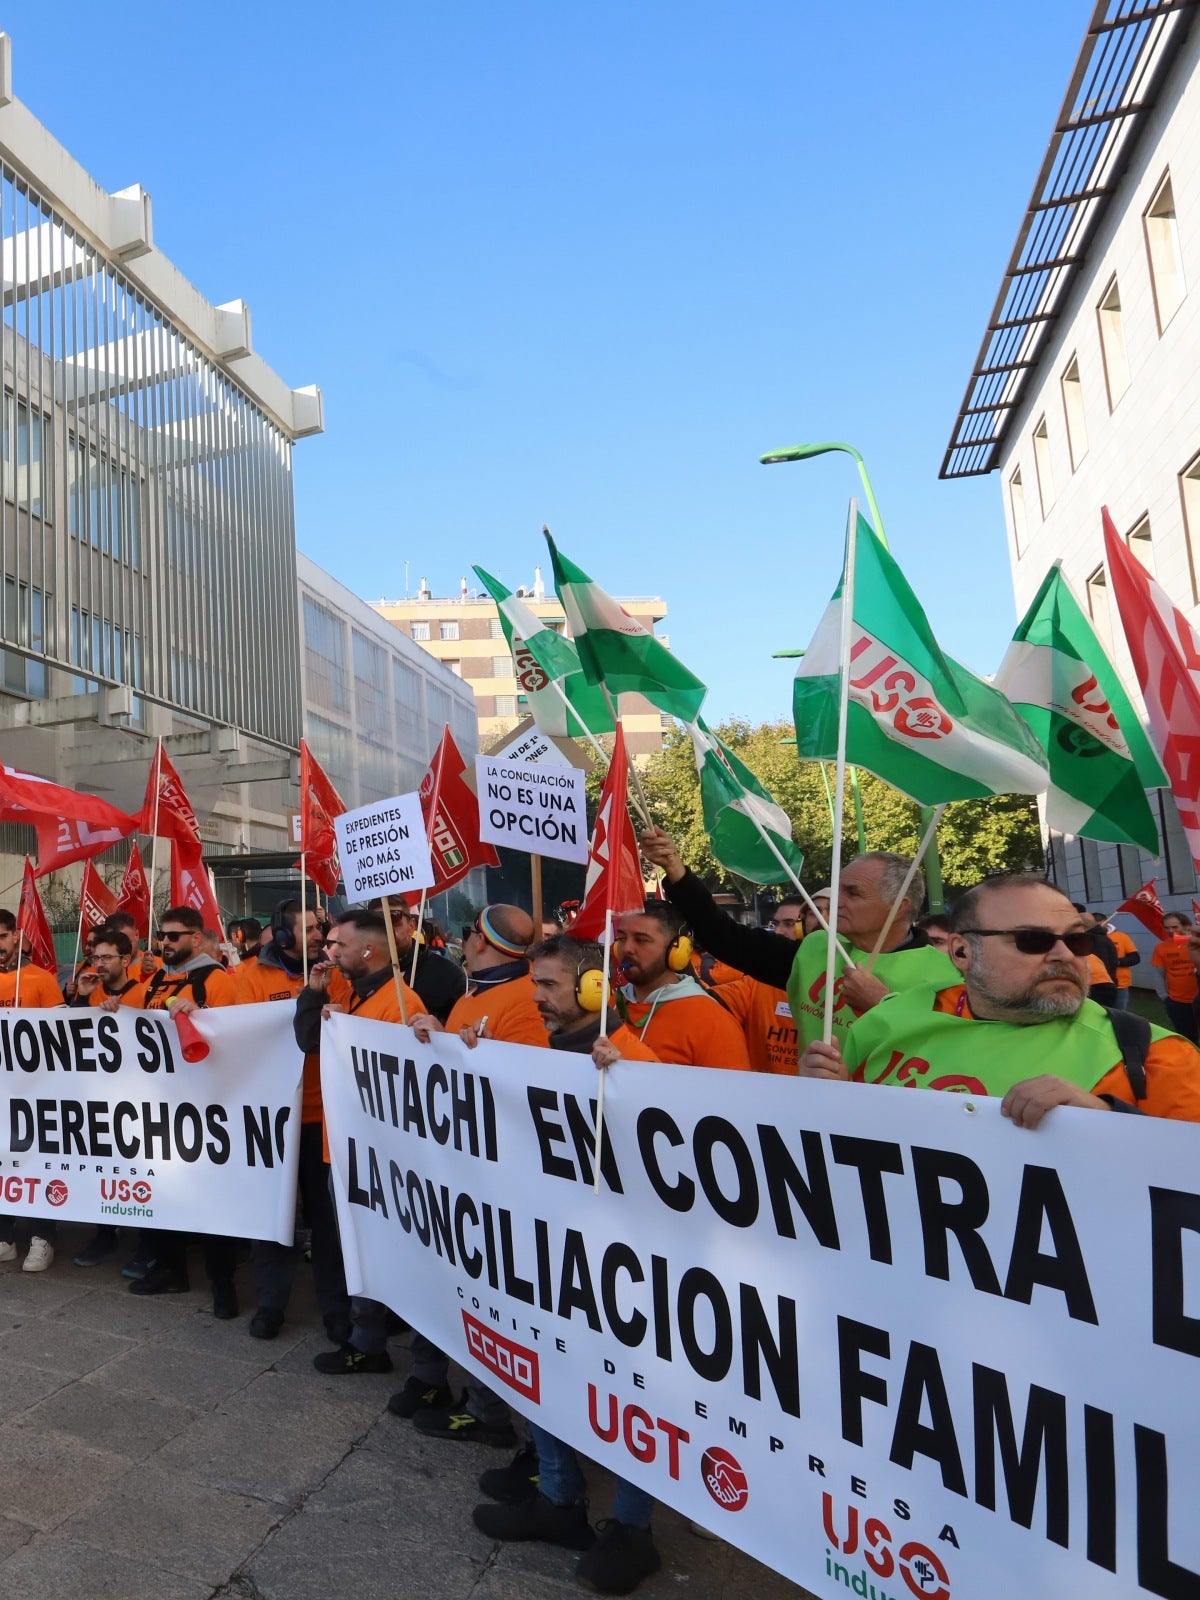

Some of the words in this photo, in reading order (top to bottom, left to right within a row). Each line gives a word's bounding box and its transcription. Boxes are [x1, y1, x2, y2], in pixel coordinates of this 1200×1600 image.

[849, 636, 953, 739] USO
[518, 742, 531, 754] DE
[487, 766, 497, 777] LA
[500, 768, 574, 789] CONCILIACIÓN
[488, 783, 511, 801] NO
[517, 788, 533, 805] ES
[539, 792, 576, 813] UNA
[345, 808, 401, 834] EXPEDIENTES
[489, 809, 576, 844] OPCIÓN
[346, 840, 357, 854] DE
[360, 824, 409, 850] PRESIÓN
[357, 855, 373, 873] ¡NO
[377, 847, 400, 865] MÁS
[354, 865, 414, 891] OPRESIÓN!
[137, 1017, 174, 1073] SI
[10, 1098, 230, 1165] DERECHOS
[45, 1162, 155, 1177] EMPRESA
[351, 1046, 498, 1162] HITACHI
[527, 1086, 624, 1195] EN
[637, 1106, 1099, 1326] CONTRA
[100, 1178, 152, 1203] USO
[101, 1202, 153, 1218] industria
[348, 1137, 389, 1220] LA
[389, 1159, 800, 1418] CONCILIACION
[838, 1314, 1200, 1600] FAMIL
[468, 1322, 533, 1389] CCOO
[457, 1287, 566, 1353] COMITE
[604, 1358, 645, 1390] DE
[695, 1400, 960, 1549] EMPRESA
[588, 1382, 690, 1481] UGT
[822, 1491, 951, 1600] USO
[825, 1548, 897, 1600] indu
